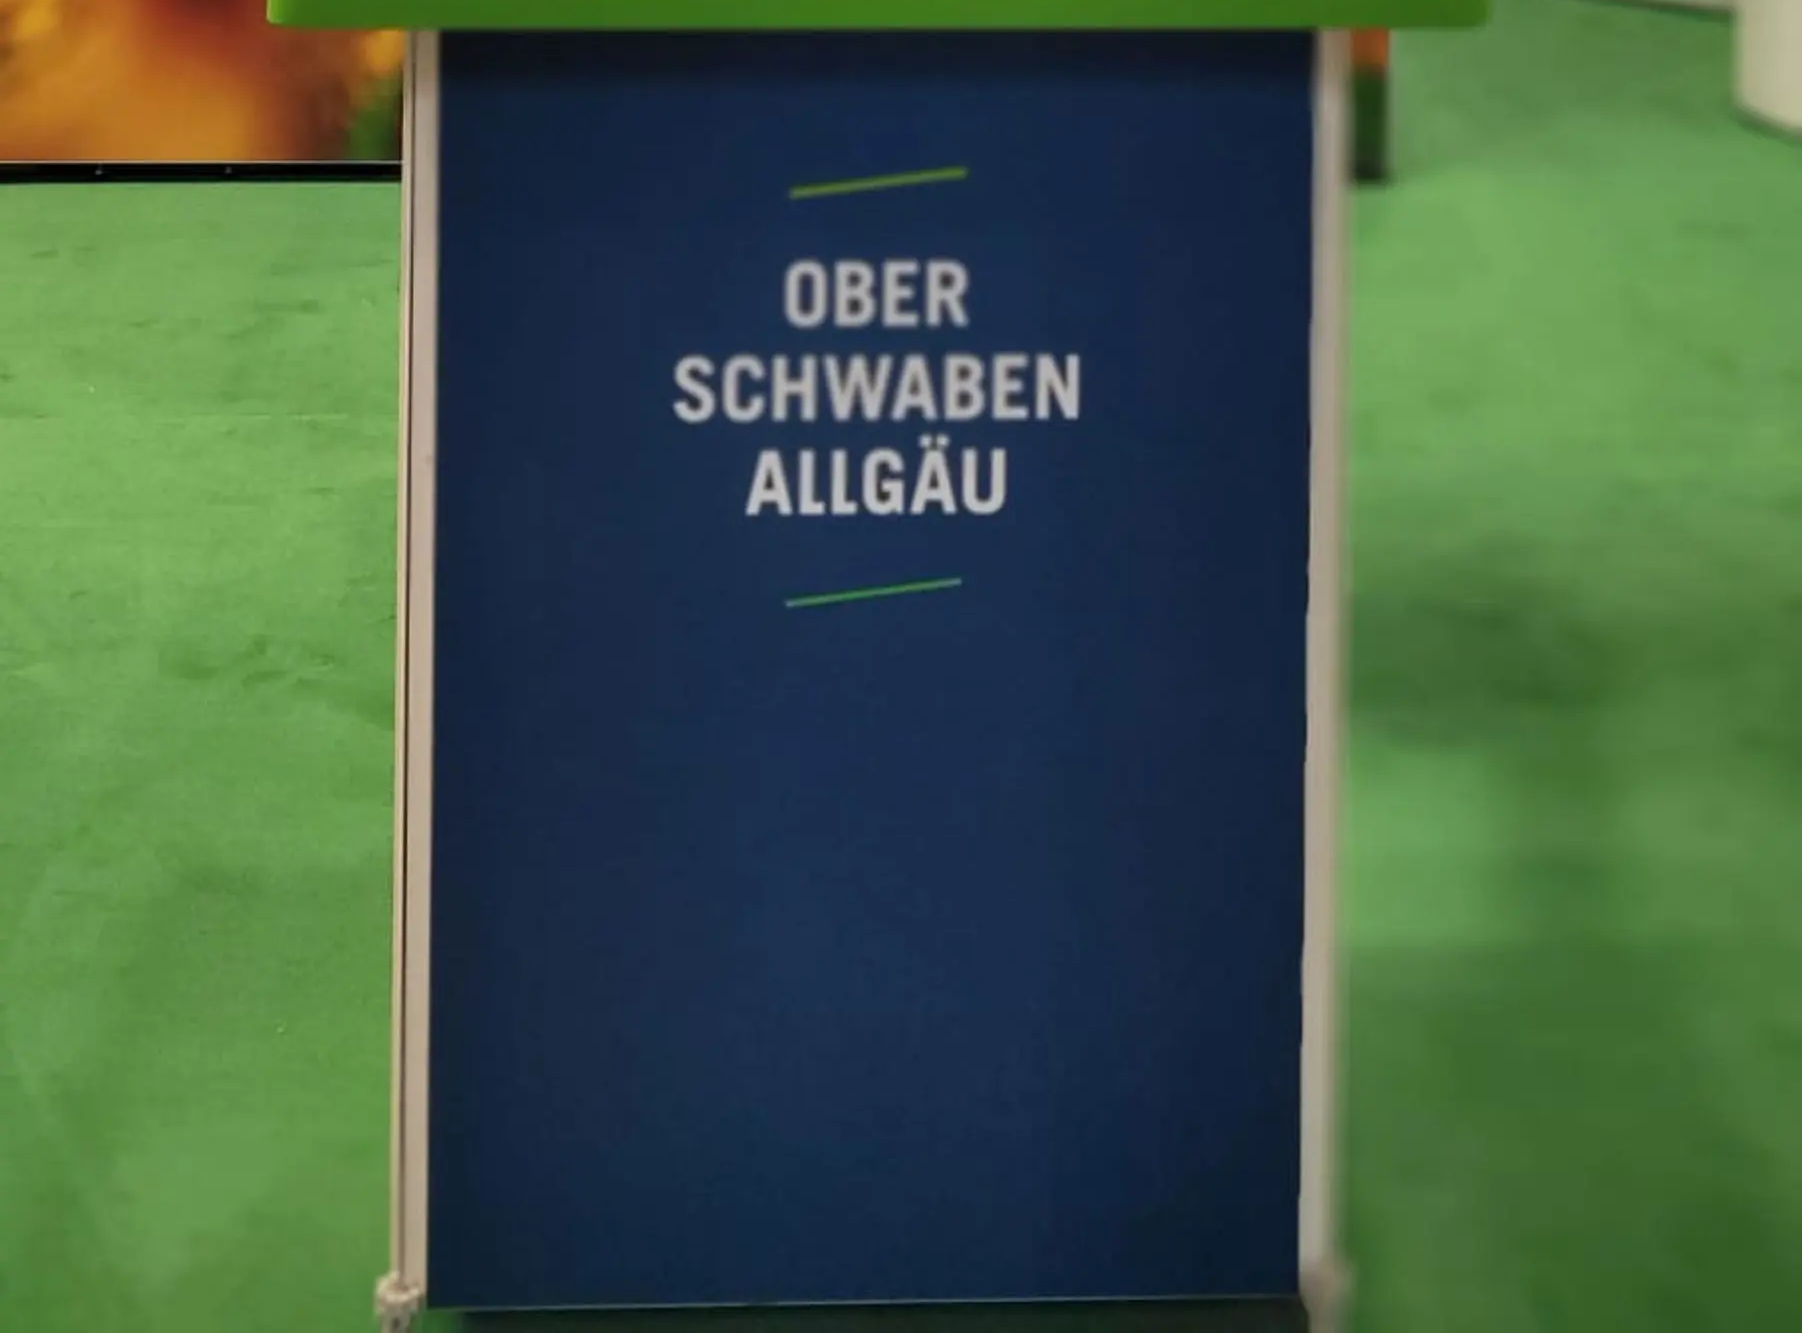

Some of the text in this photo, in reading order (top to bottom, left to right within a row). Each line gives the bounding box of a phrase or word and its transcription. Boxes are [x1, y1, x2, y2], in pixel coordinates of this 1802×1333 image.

[785, 260, 969, 328] OBER
[673, 354, 1081, 423] SCHWABEN
[745, 434, 1007, 516] ALLGÄU
